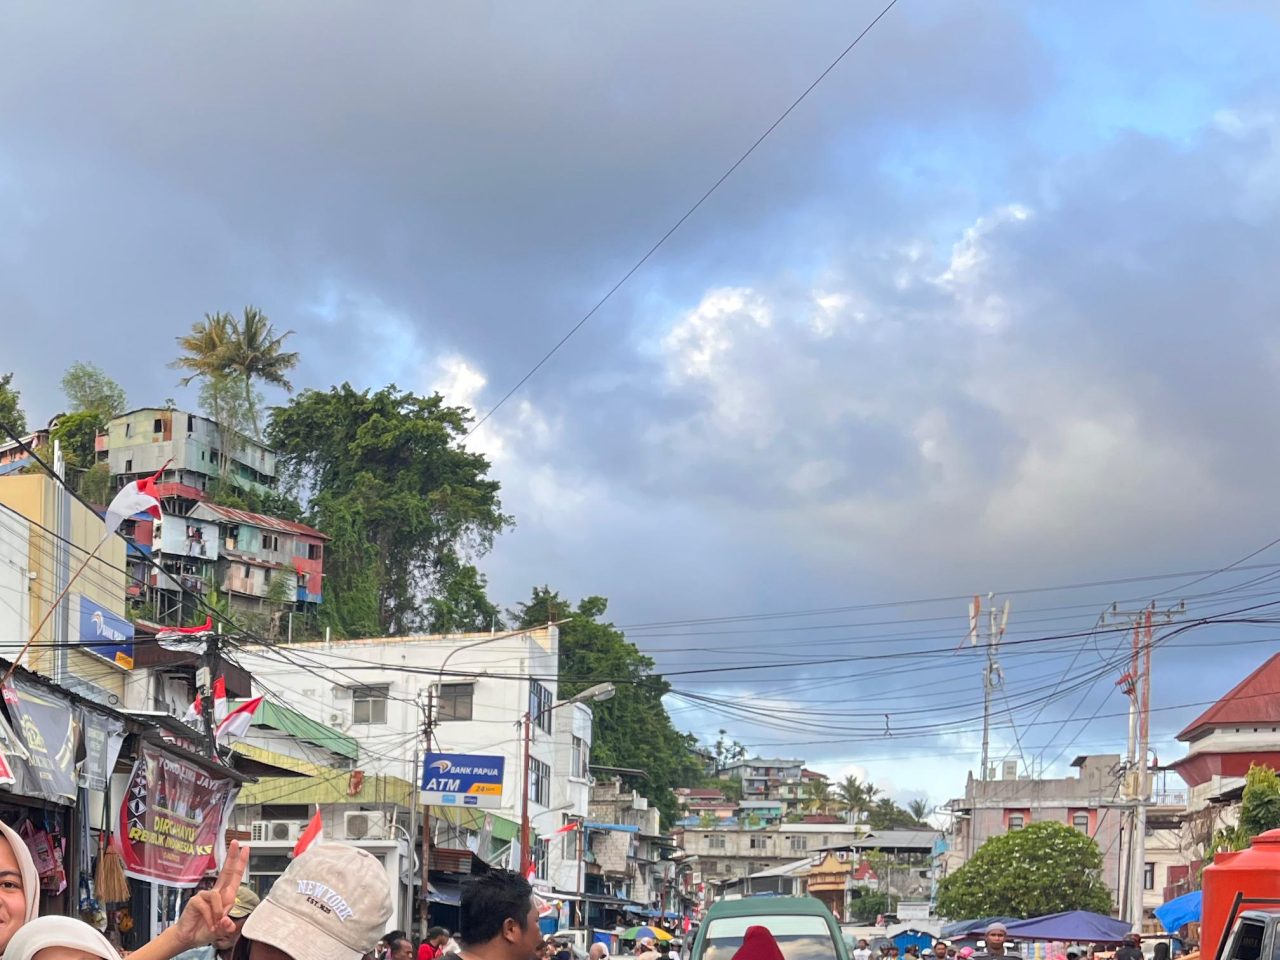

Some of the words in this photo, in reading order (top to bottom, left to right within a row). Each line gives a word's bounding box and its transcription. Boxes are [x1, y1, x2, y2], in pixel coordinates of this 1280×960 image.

[450, 766, 471, 775] BANK
[473, 767, 498, 776] PAPUA
[426, 778, 460, 791] ATM
[296, 880, 328, 900] NEW
[322, 889, 353, 921] YORK
